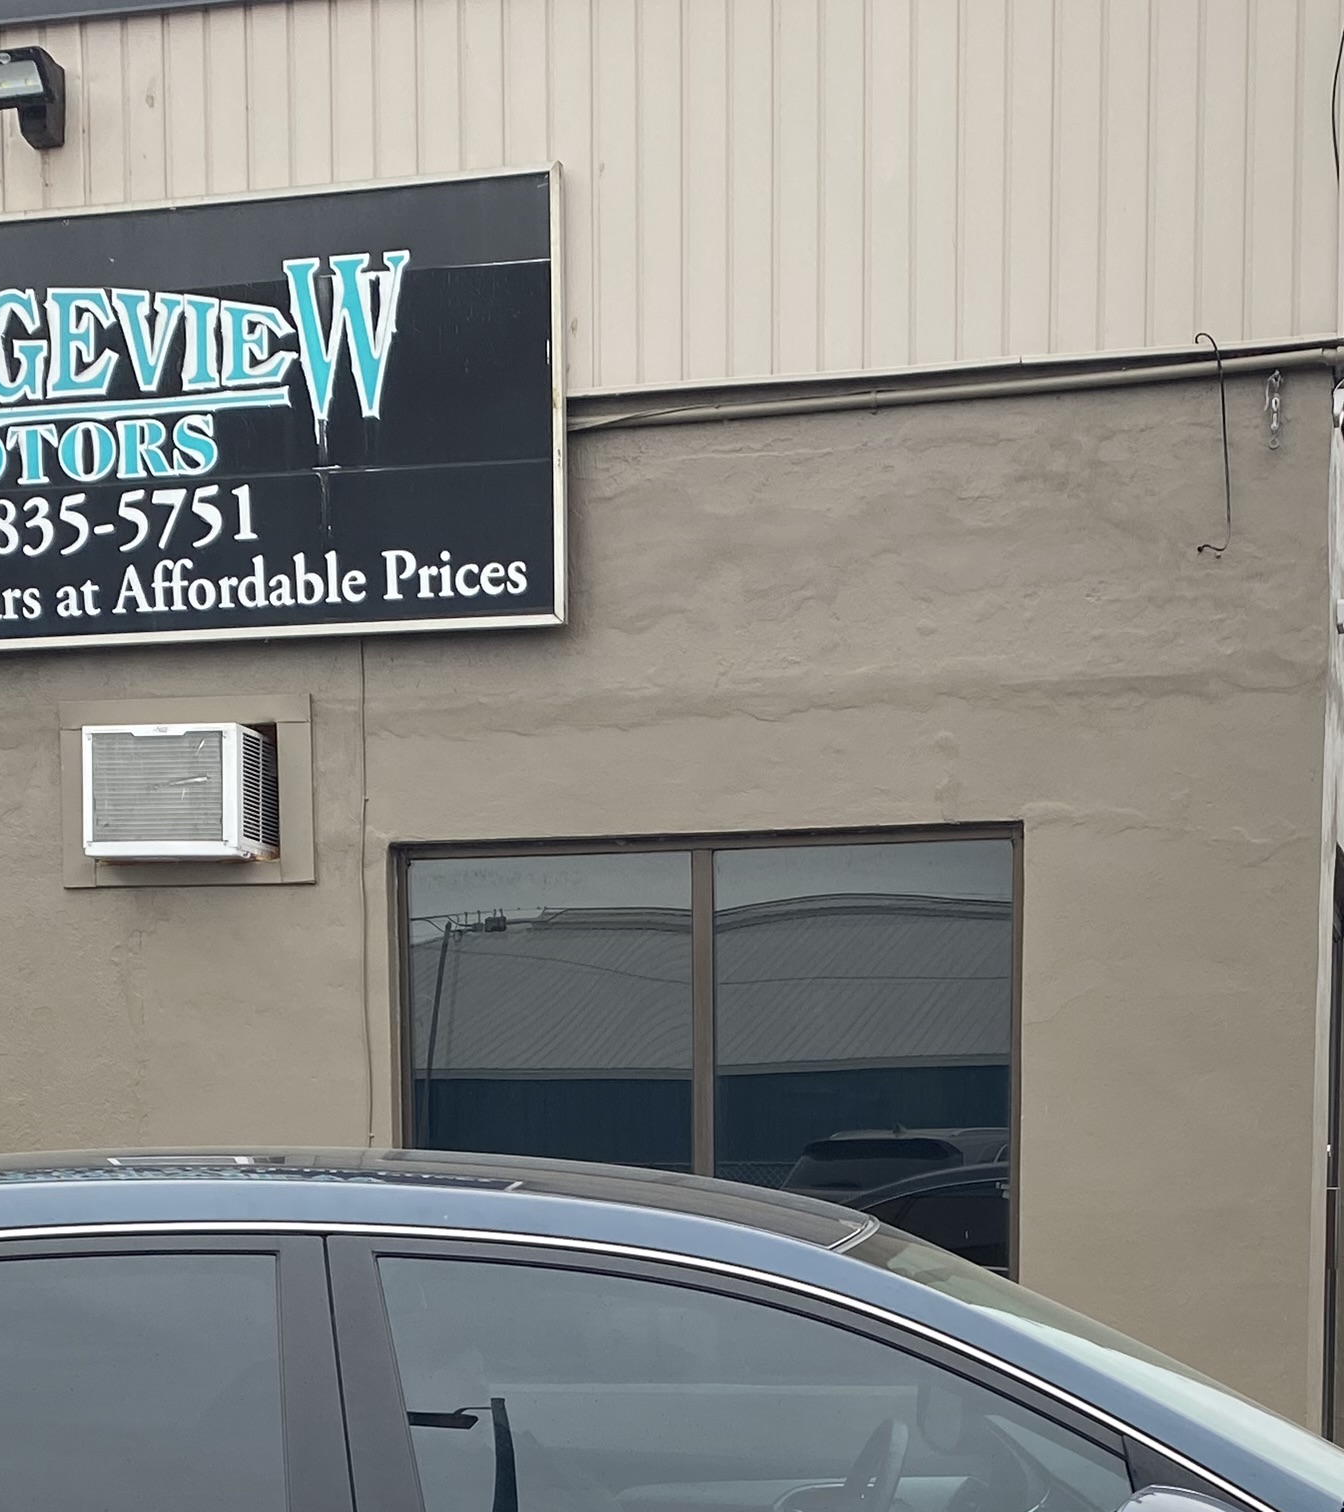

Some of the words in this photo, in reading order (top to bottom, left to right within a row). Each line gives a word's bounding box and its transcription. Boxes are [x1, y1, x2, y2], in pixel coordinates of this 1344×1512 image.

[56, 579, 102, 617] at
[112, 550, 367, 614] Affordable
[381, 550, 528, 601] Prices
